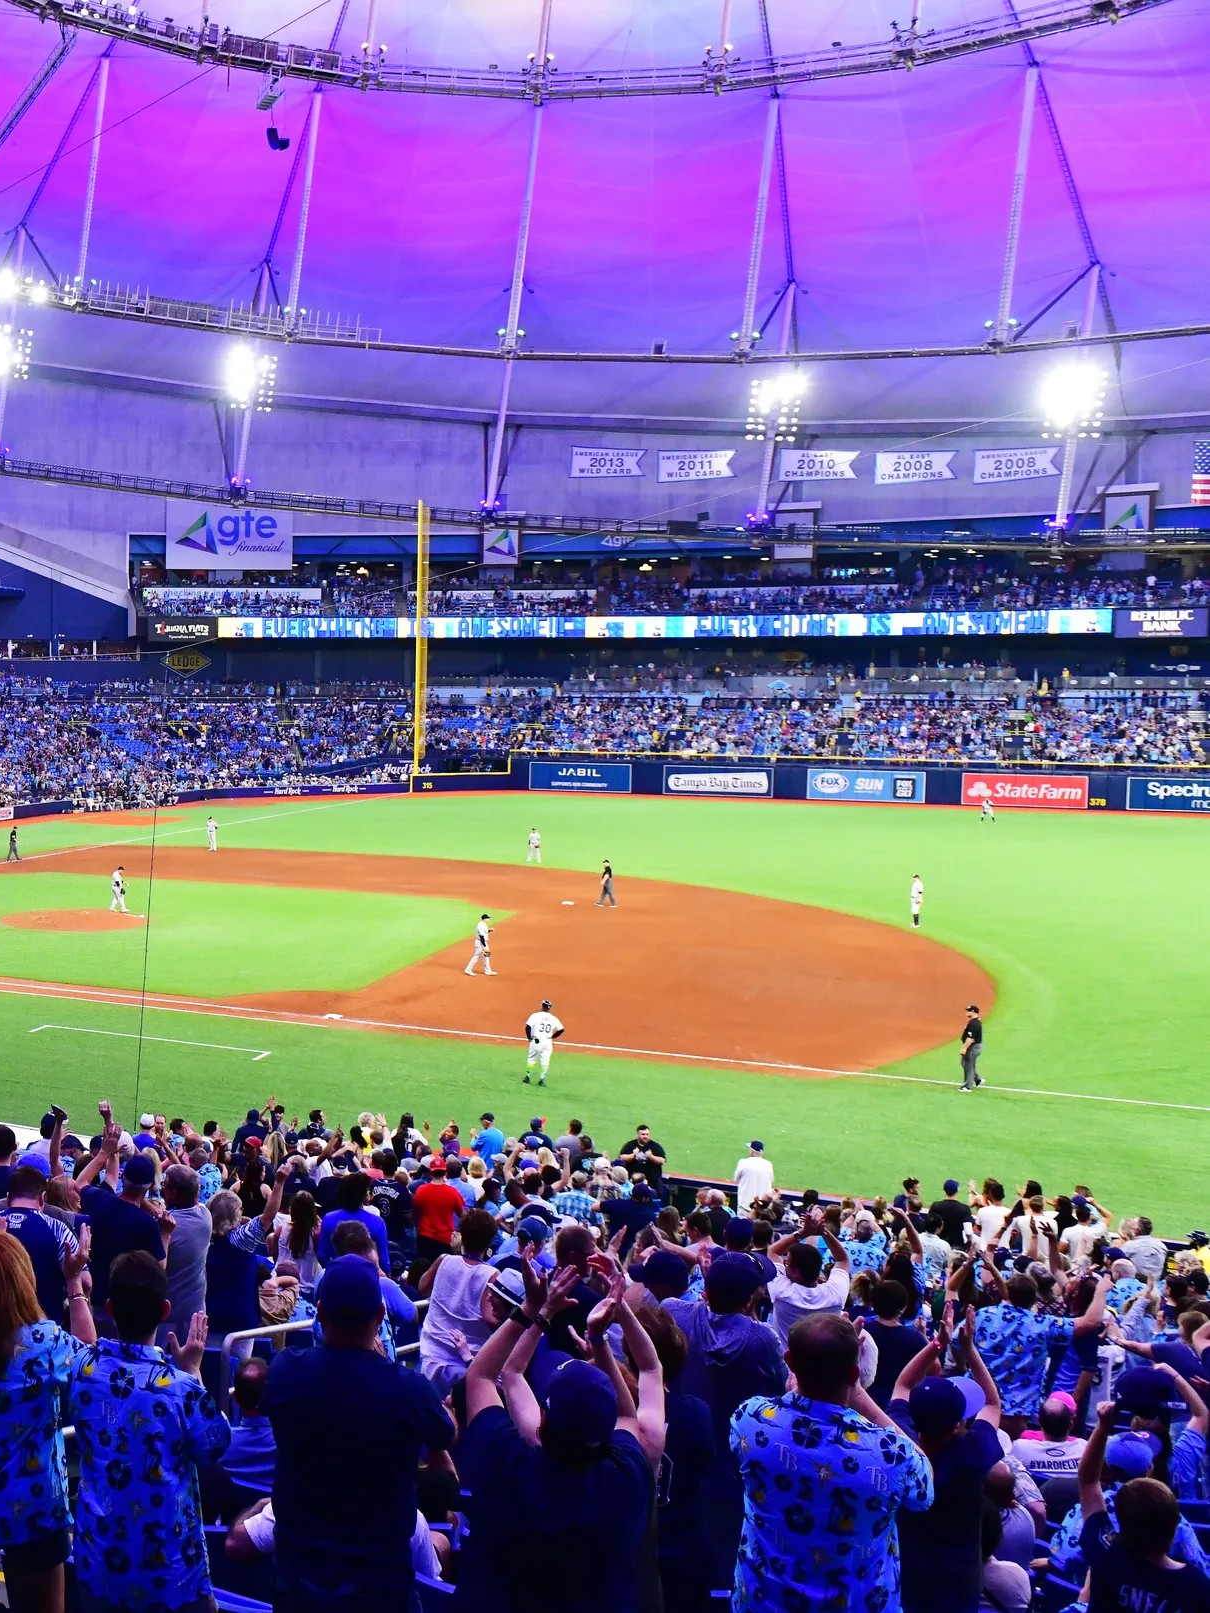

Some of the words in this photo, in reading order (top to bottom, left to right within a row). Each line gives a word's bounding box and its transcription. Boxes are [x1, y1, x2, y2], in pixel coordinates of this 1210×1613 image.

[589, 457, 624, 468] 2013
[678, 460, 712, 471] 2011
[797, 459, 836, 470] 2010
[893, 460, 933, 472] 2008
[993, 457, 1037, 471] 2008
[784, 470, 845, 478] CHAMPIONS
[880, 471, 944, 480] CHAMPIONS
[980, 467, 1048, 480] CHAMPIONS
[217, 511, 278, 546] gte
[228, 540, 284, 557] financial
[1130, 609, 1195, 621] REPUBLIC
[262, 617, 385, 638] EVERYTHING
[694, 614, 836, 637] EVERYTHING
[862, 613, 891, 636] IS
[1142, 620, 1182, 631] BANK
[172, 655, 201, 667] LEDGE
[383, 763, 408, 775] Hard
[557, 767, 602, 777] JABIL
[673, 776, 707, 789] Tampa
[709, 777, 730, 789] Bay
[731, 777, 763, 789] Times
[820, 777, 840, 786] FOX
[854, 777, 884, 791] SUN
[274, 787, 288, 795] Hard
[288, 787, 301, 796] Rock
[1089, 798, 1107, 807] 378
[539, 1023, 552, 1033] 30
[373, 1185, 400, 1200] ONGORIA
[774, 1442, 798, 1472] TB
[865, 1466, 889, 1492] TB
